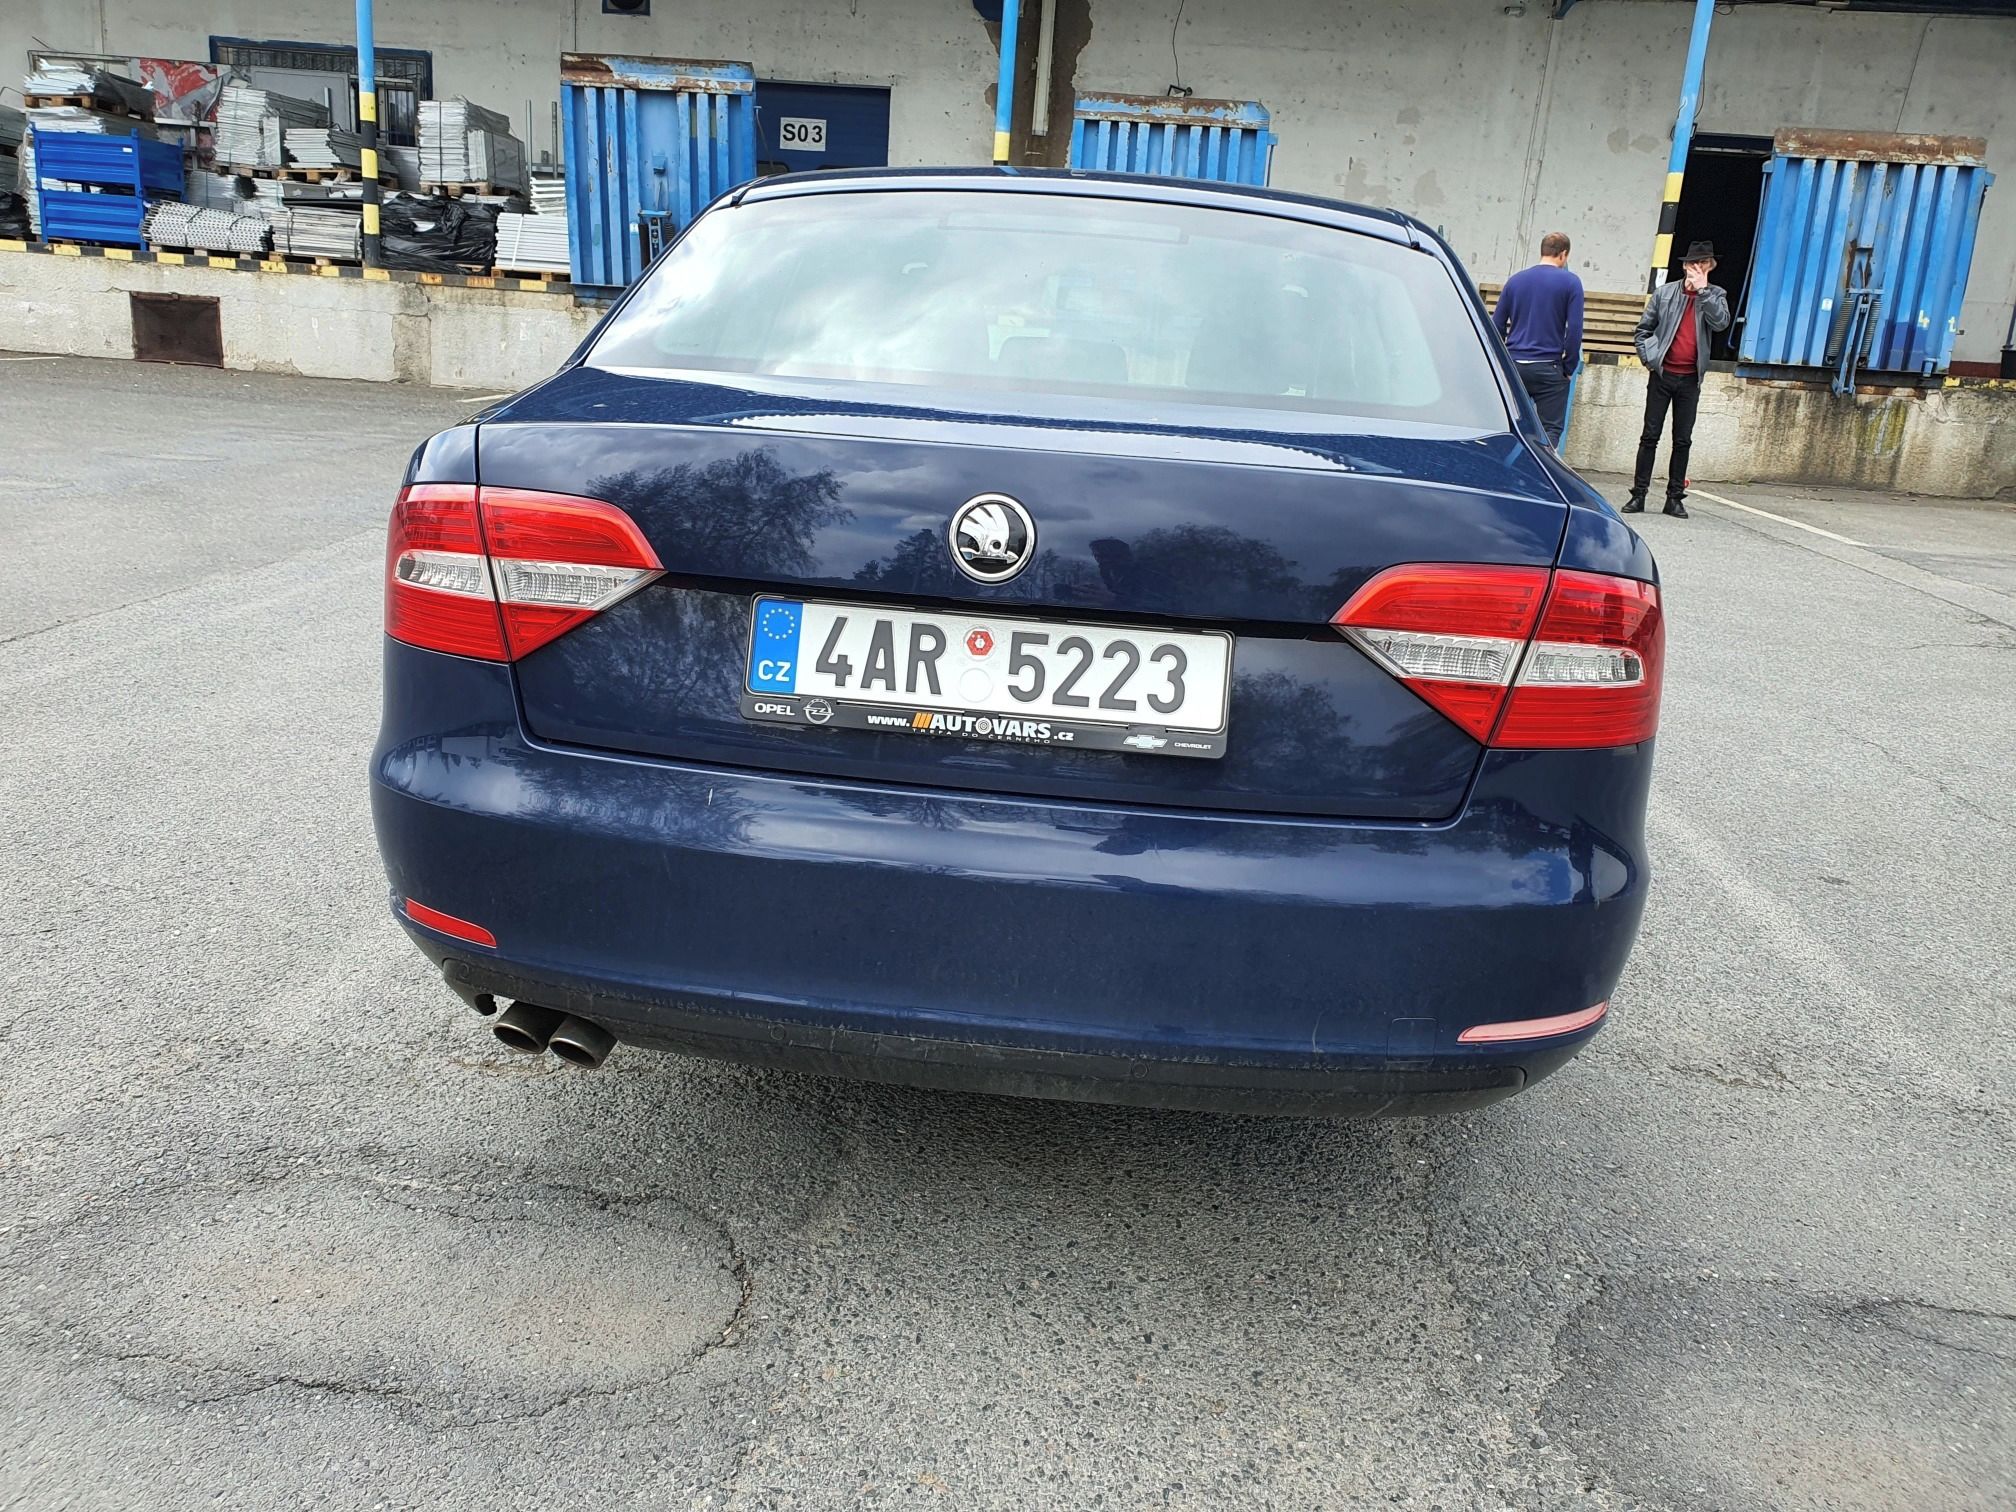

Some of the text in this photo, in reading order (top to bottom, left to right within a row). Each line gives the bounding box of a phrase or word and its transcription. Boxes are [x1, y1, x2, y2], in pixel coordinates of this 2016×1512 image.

[782, 123, 823, 143] S03
[757, 659, 791, 683] CZ
[815, 616, 1189, 715] 4AR 5223
[754, 702, 796, 717] OPEL
[1174, 742, 1212, 750] CHEVROLET
